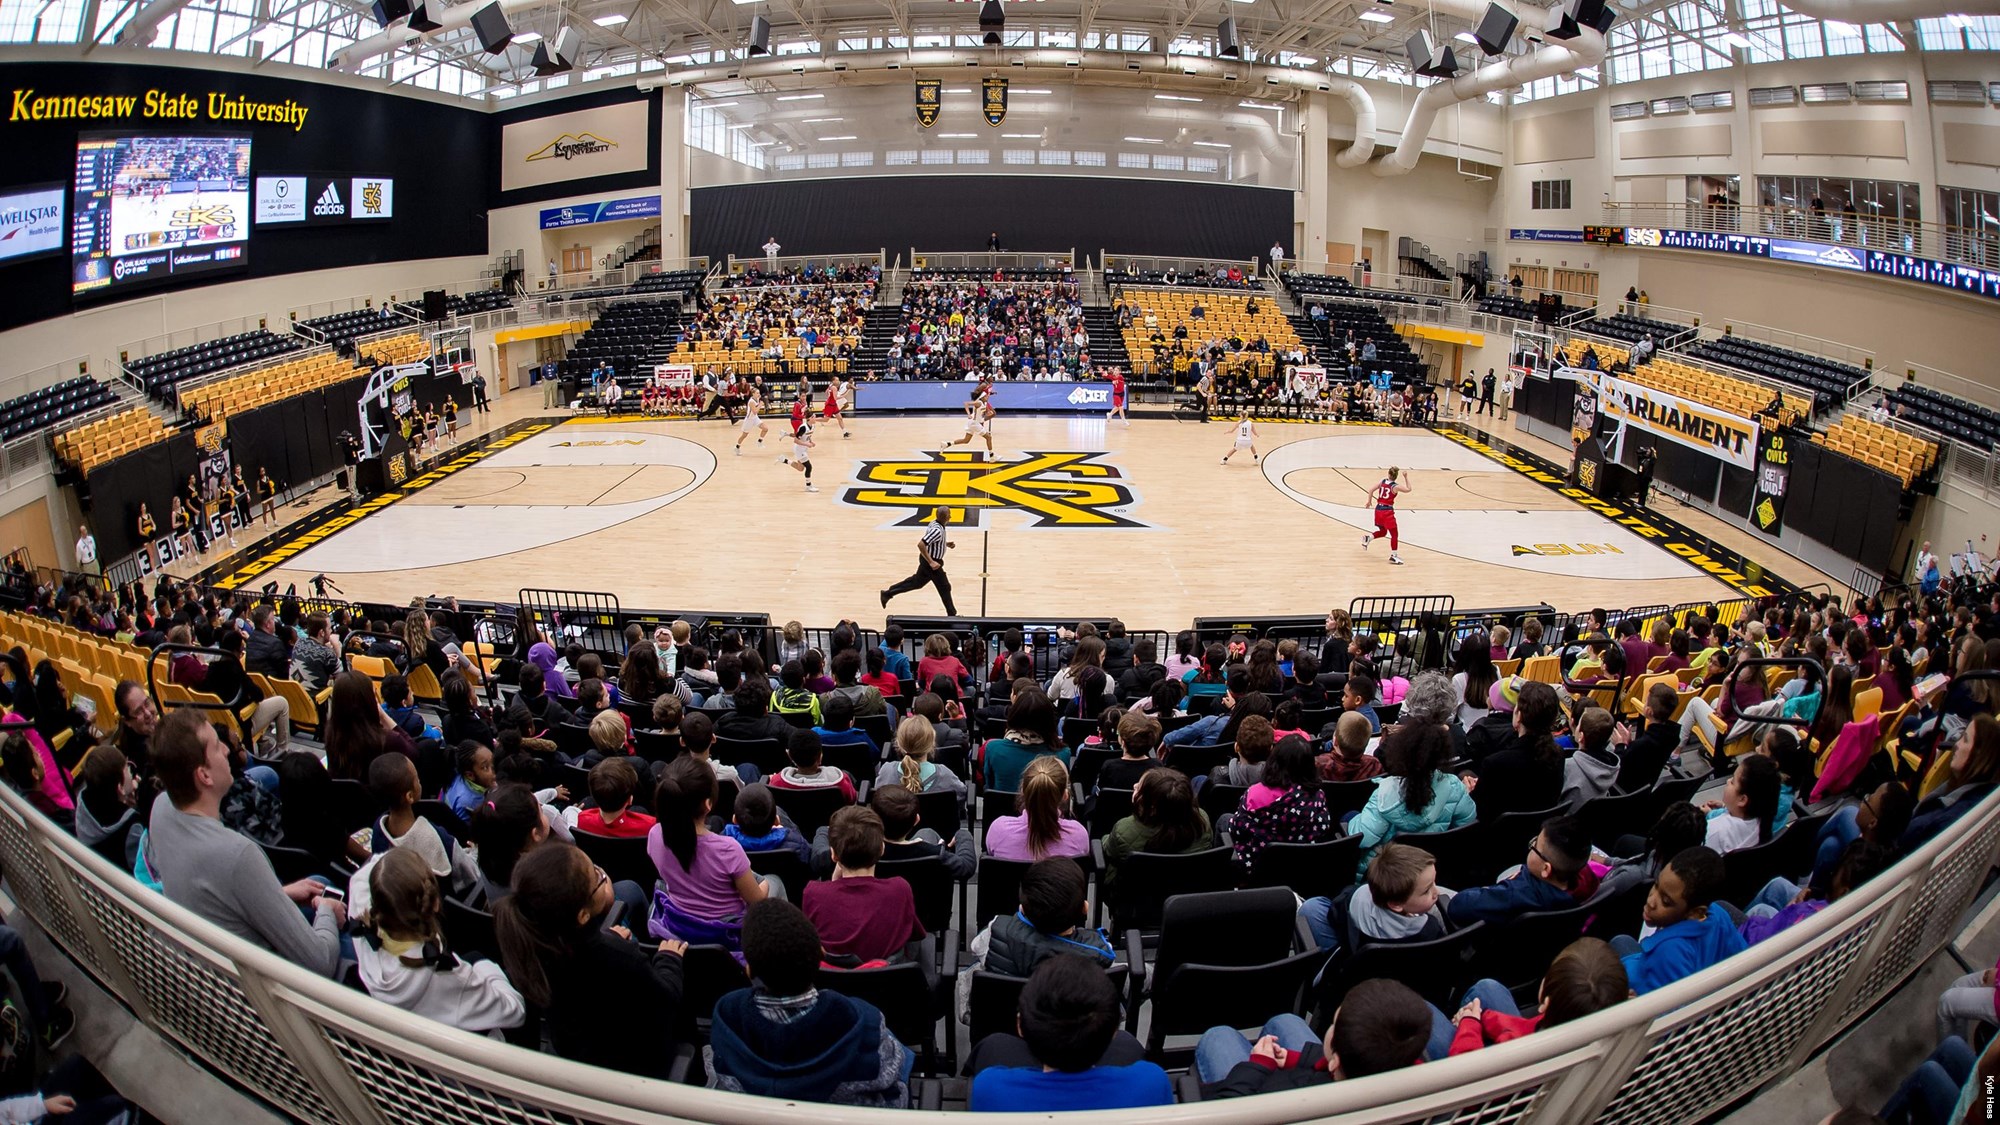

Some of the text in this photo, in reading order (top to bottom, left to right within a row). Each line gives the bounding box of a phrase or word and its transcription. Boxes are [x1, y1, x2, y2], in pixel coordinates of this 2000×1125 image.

[9, 89, 308, 131] Kennesaw State University
[554, 140, 596, 154] Kennesaw
[0, 205, 57, 226] WELLSTAR
[313, 203, 345, 215] adidas
[138, 233, 149, 247] 11
[169, 229, 187, 241] 3:20
[1757, 244, 1763, 254] 2
[658, 369, 690, 379] ESPN
[393, 377, 409, 393] OWLS
[485, 424, 552, 448] OWLS
[1772, 436, 1783, 450] GO
[1766, 448, 1788, 464] OWLS
[402, 450, 495, 489] STATE
[1765, 468, 1776, 480] GET
[1379, 486, 1391, 499] 13
[211, 514, 225, 538] 3
[214, 492, 403, 590] KENNESAW
[1558, 488, 1669, 538] STATE
[1664, 543, 1775, 598] OWLS
[158, 539, 172, 565] 3
